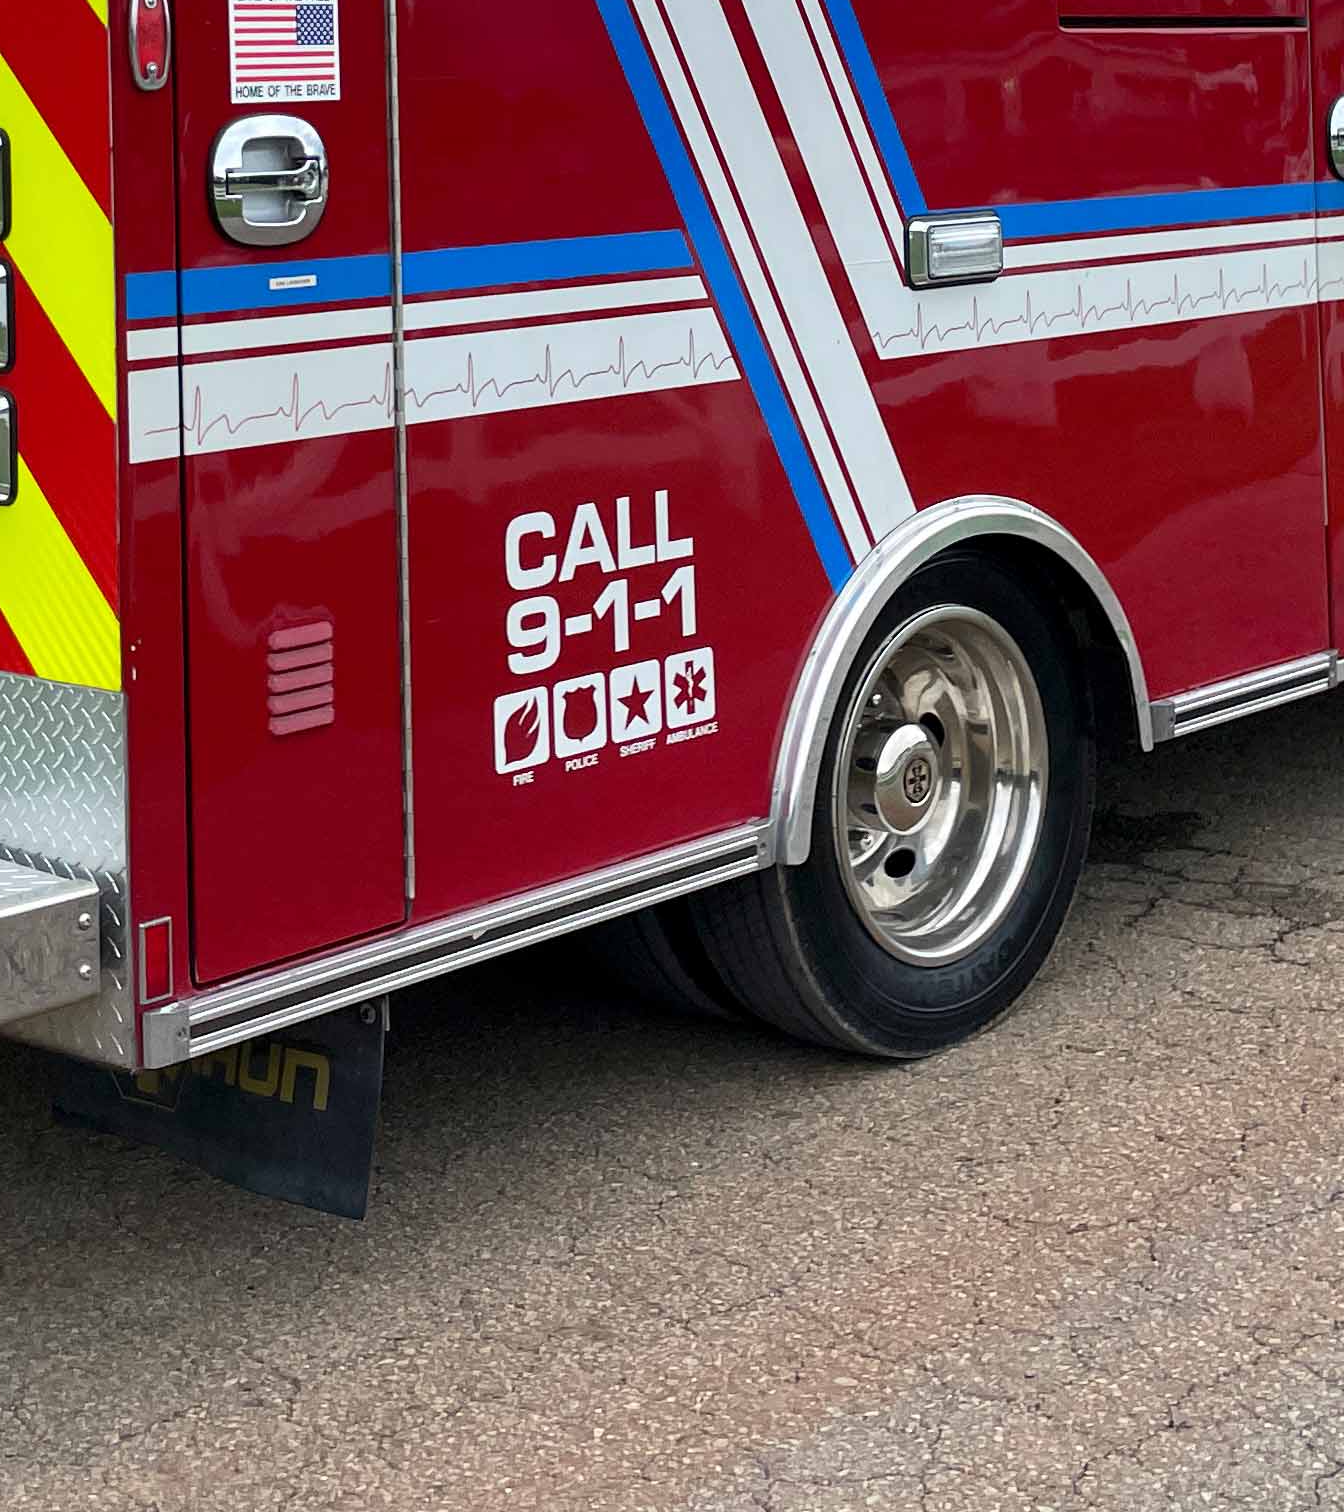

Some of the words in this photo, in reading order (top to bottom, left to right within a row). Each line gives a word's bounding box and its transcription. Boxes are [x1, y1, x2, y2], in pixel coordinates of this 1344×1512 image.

[235, 85, 264, 98] HOME
[268, 85, 281, 97] OF
[285, 84, 303, 96] THE
[306, 83, 336, 96] BRAVE
[505, 490, 694, 590] CALL
[507, 565, 697, 675] 9-1-1
[666, 721, 719, 745] AMBULANCE
[619, 738, 656, 757] SHERIFF
[565, 753, 599, 772] POLICE
[513, 771, 534, 786] FIRE
